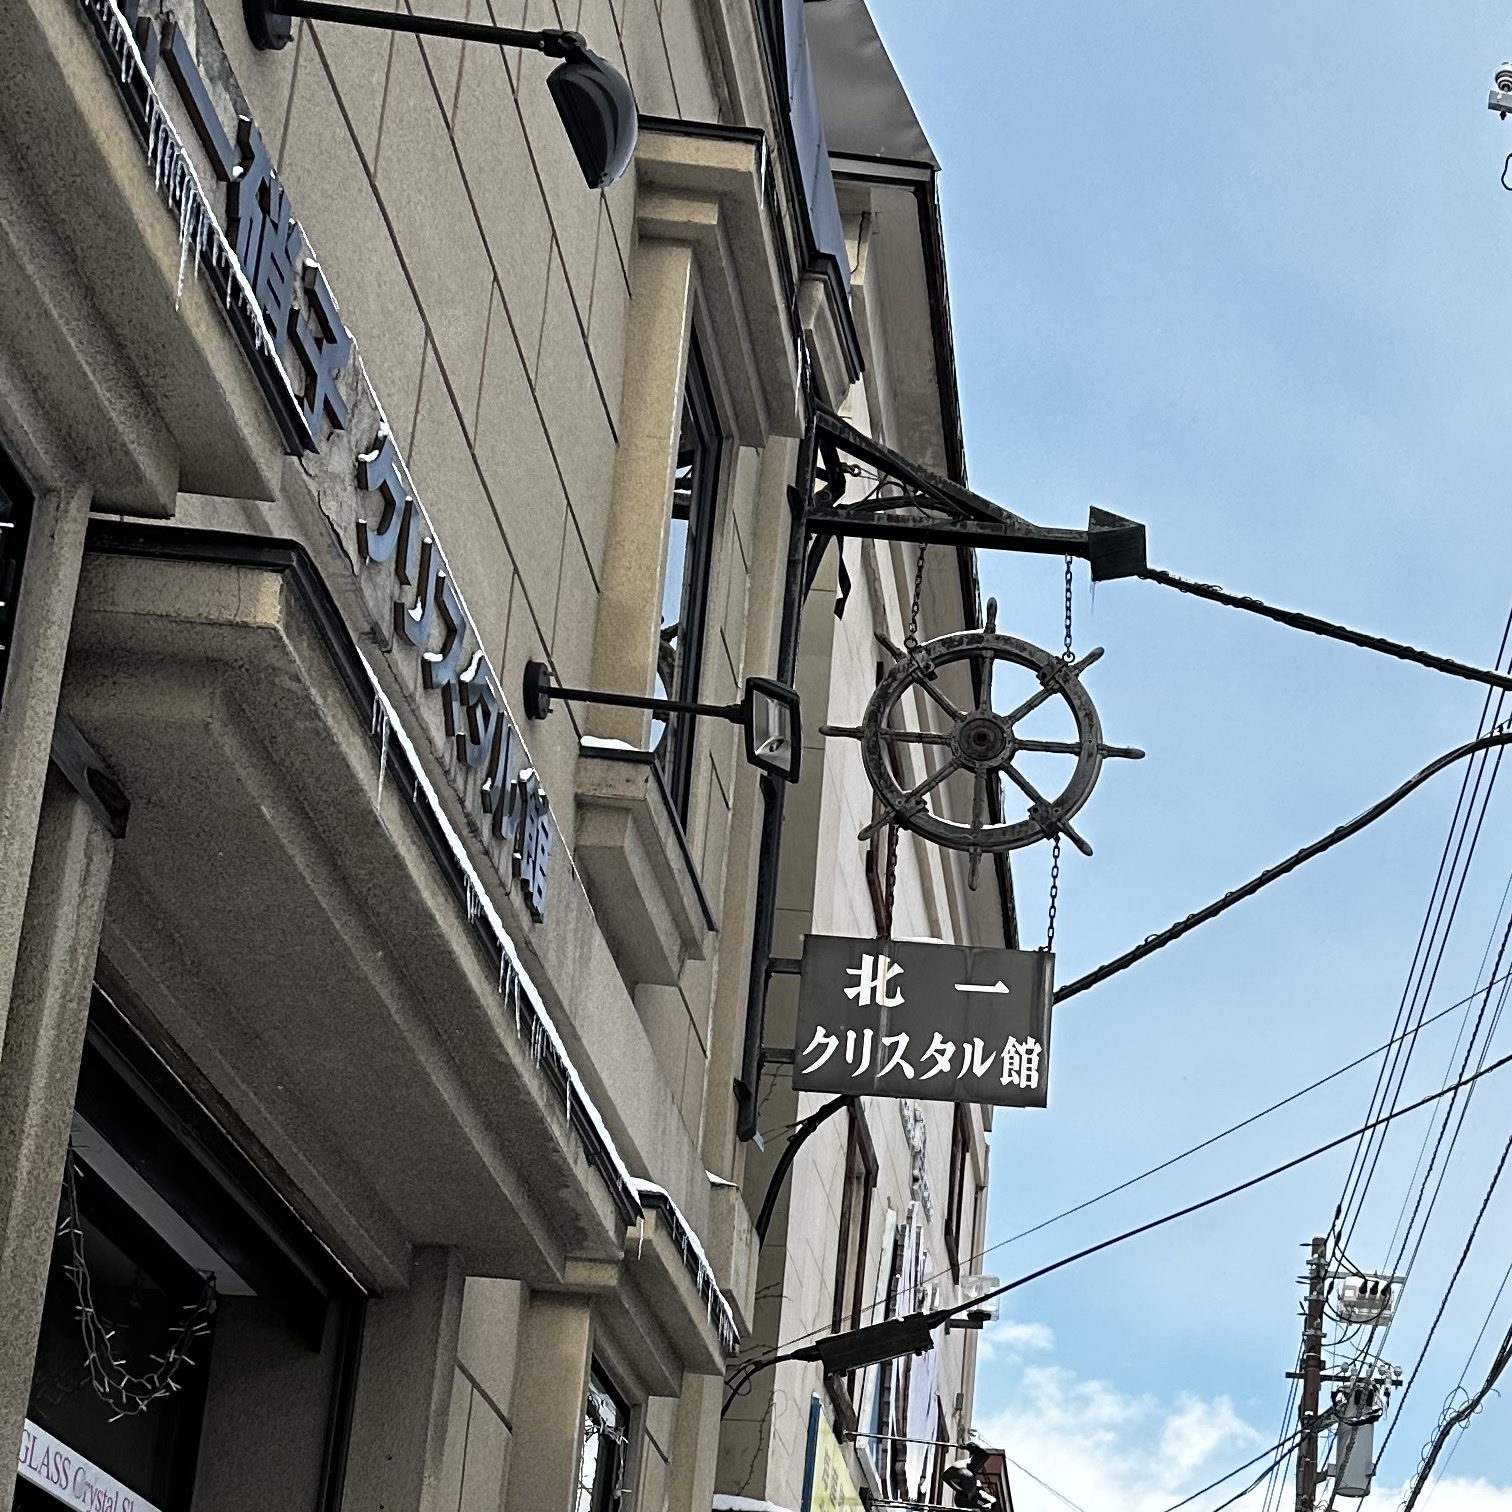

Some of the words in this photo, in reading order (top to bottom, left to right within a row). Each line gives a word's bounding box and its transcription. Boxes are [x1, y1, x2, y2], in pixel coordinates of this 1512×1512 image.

[801, 1025, 1042, 1088] クリスタル館
[18, 1429, 71, 1490] GLASS
